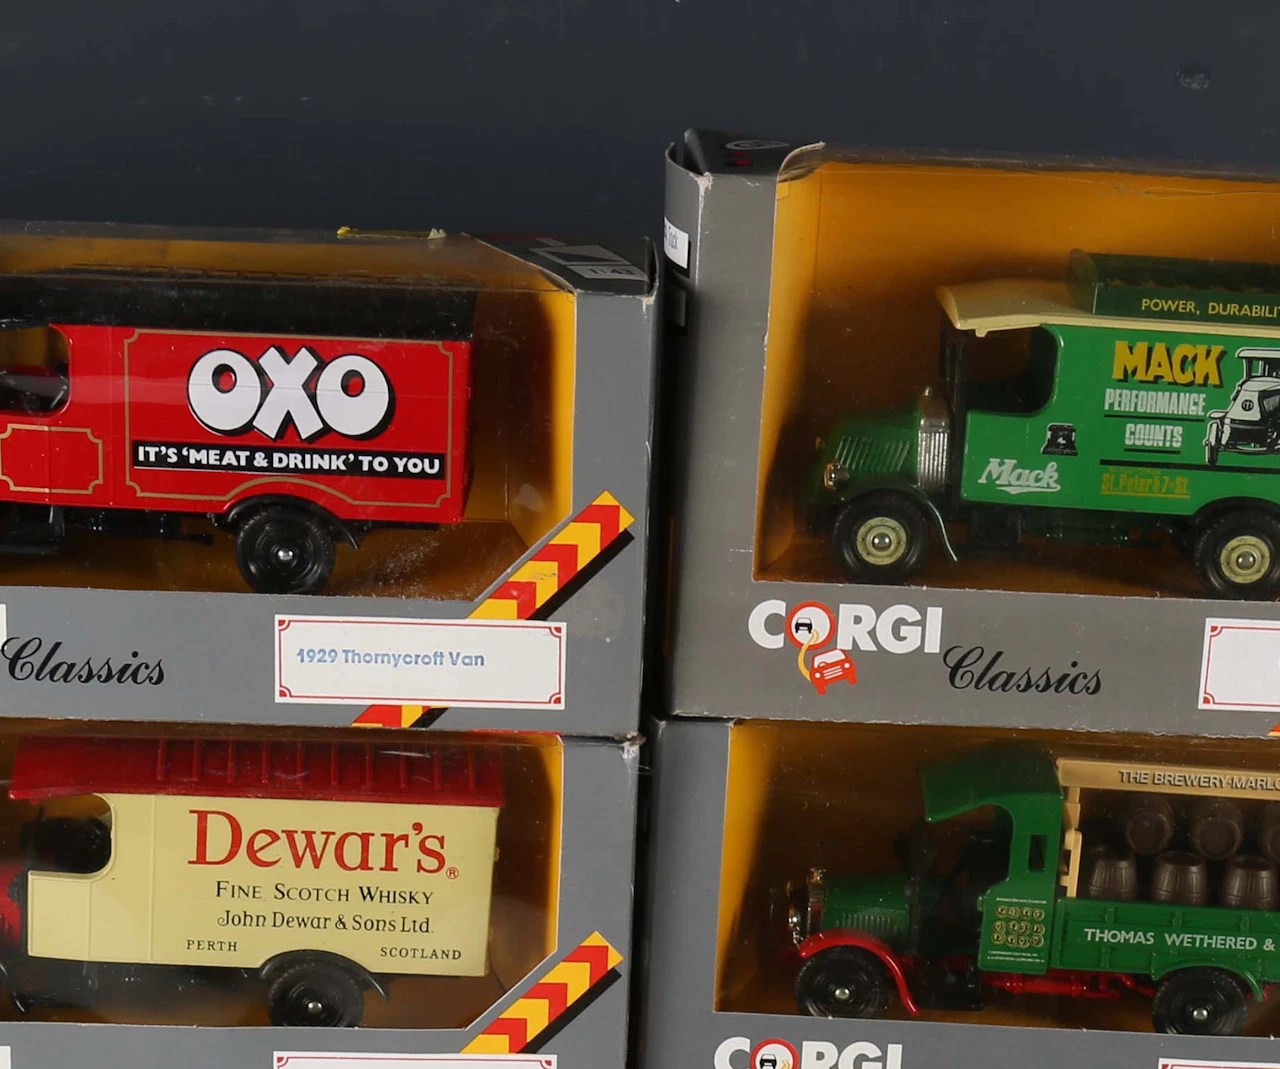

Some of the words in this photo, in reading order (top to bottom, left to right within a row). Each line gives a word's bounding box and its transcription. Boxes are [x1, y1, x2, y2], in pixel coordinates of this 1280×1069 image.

[1112, 339, 1225, 387] MACK
[187, 345, 396, 442] OXO
[1104, 388, 1206, 415] PERFORMANCE
[1124, 423, 1183, 447] COUNTS
[138, 445, 178, 464] IT'S
[253, 452, 268, 468] &
[358, 455, 388, 471] TO
[394, 457, 440, 474] YOU
[978, 458, 1061, 489] Mack
[748, 599, 942, 654] CORGI
[1, 637, 165, 686] Classics
[296, 647, 339, 666] 1929
[342, 646, 446, 669] Thornycroft
[449, 649, 485, 667] Van
[943, 645, 1102, 695] Classics
[1120, 769, 1149, 784] THE
[188, 809, 446, 874] Dewar's
[274, 882, 350, 902] SCOTCH
[359, 886, 434, 905] WHISKY
[217, 910, 267, 928] John
[272, 911, 331, 930] Dewar
[335, 914, 348, 930] &
[352, 914, 396, 932] Sons
[186, 939, 238, 952] PERTH
[380, 946, 462, 960] SCOTLAND
[1084, 928, 1155, 945] THOMAS
[1164, 932, 1257, 950] WETHERED
[1263, 938, 1275, 951] &
